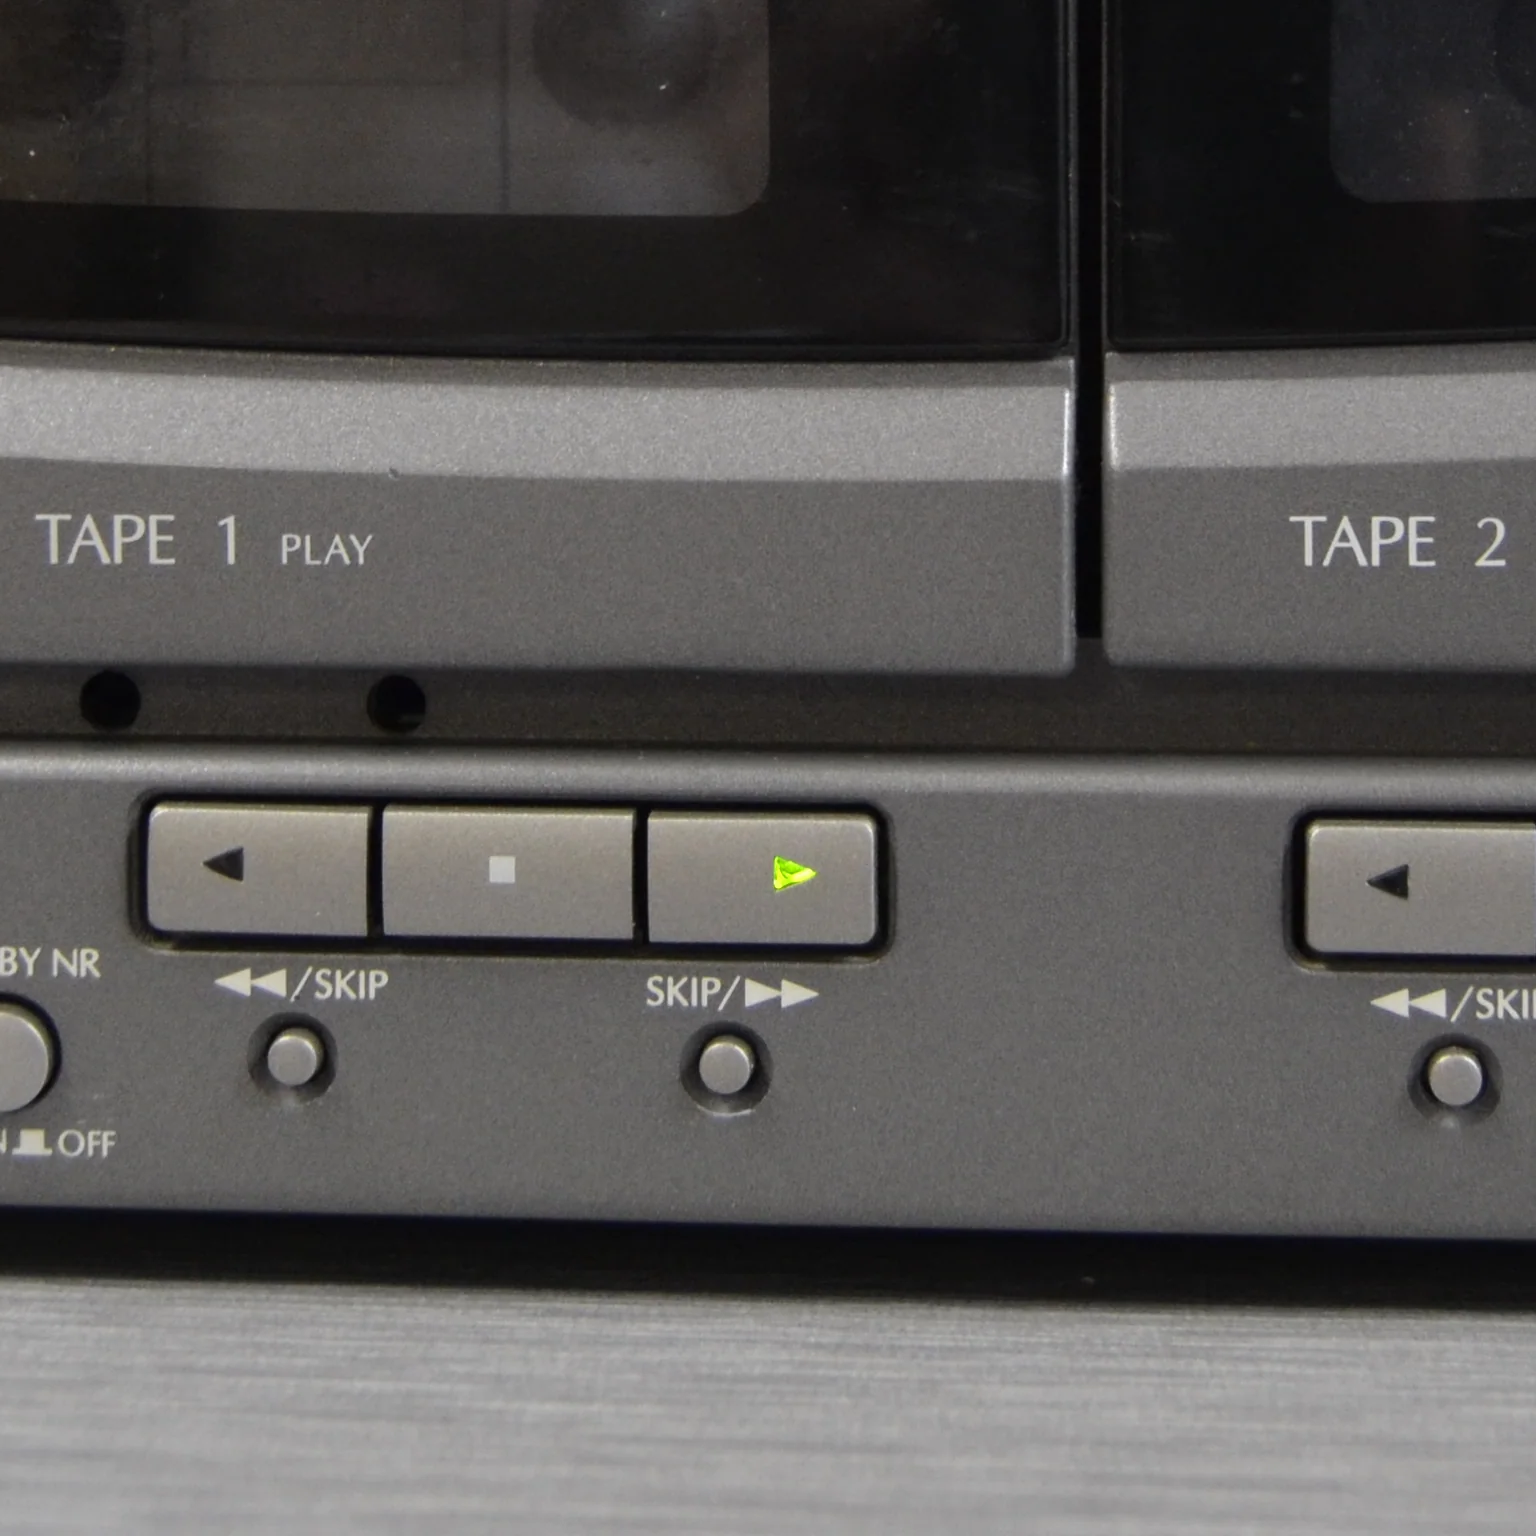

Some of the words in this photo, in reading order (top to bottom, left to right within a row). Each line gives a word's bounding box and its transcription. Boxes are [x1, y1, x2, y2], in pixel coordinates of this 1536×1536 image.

[34, 513, 176, 566] TAPE
[216, 514, 238, 566] 1
[281, 534, 374, 566] PLAY
[1288, 515, 1437, 568] TAPE
[1474, 516, 1508, 568] 2
[52, 947, 102, 979] NR
[57, 1130, 117, 1158] OFF
